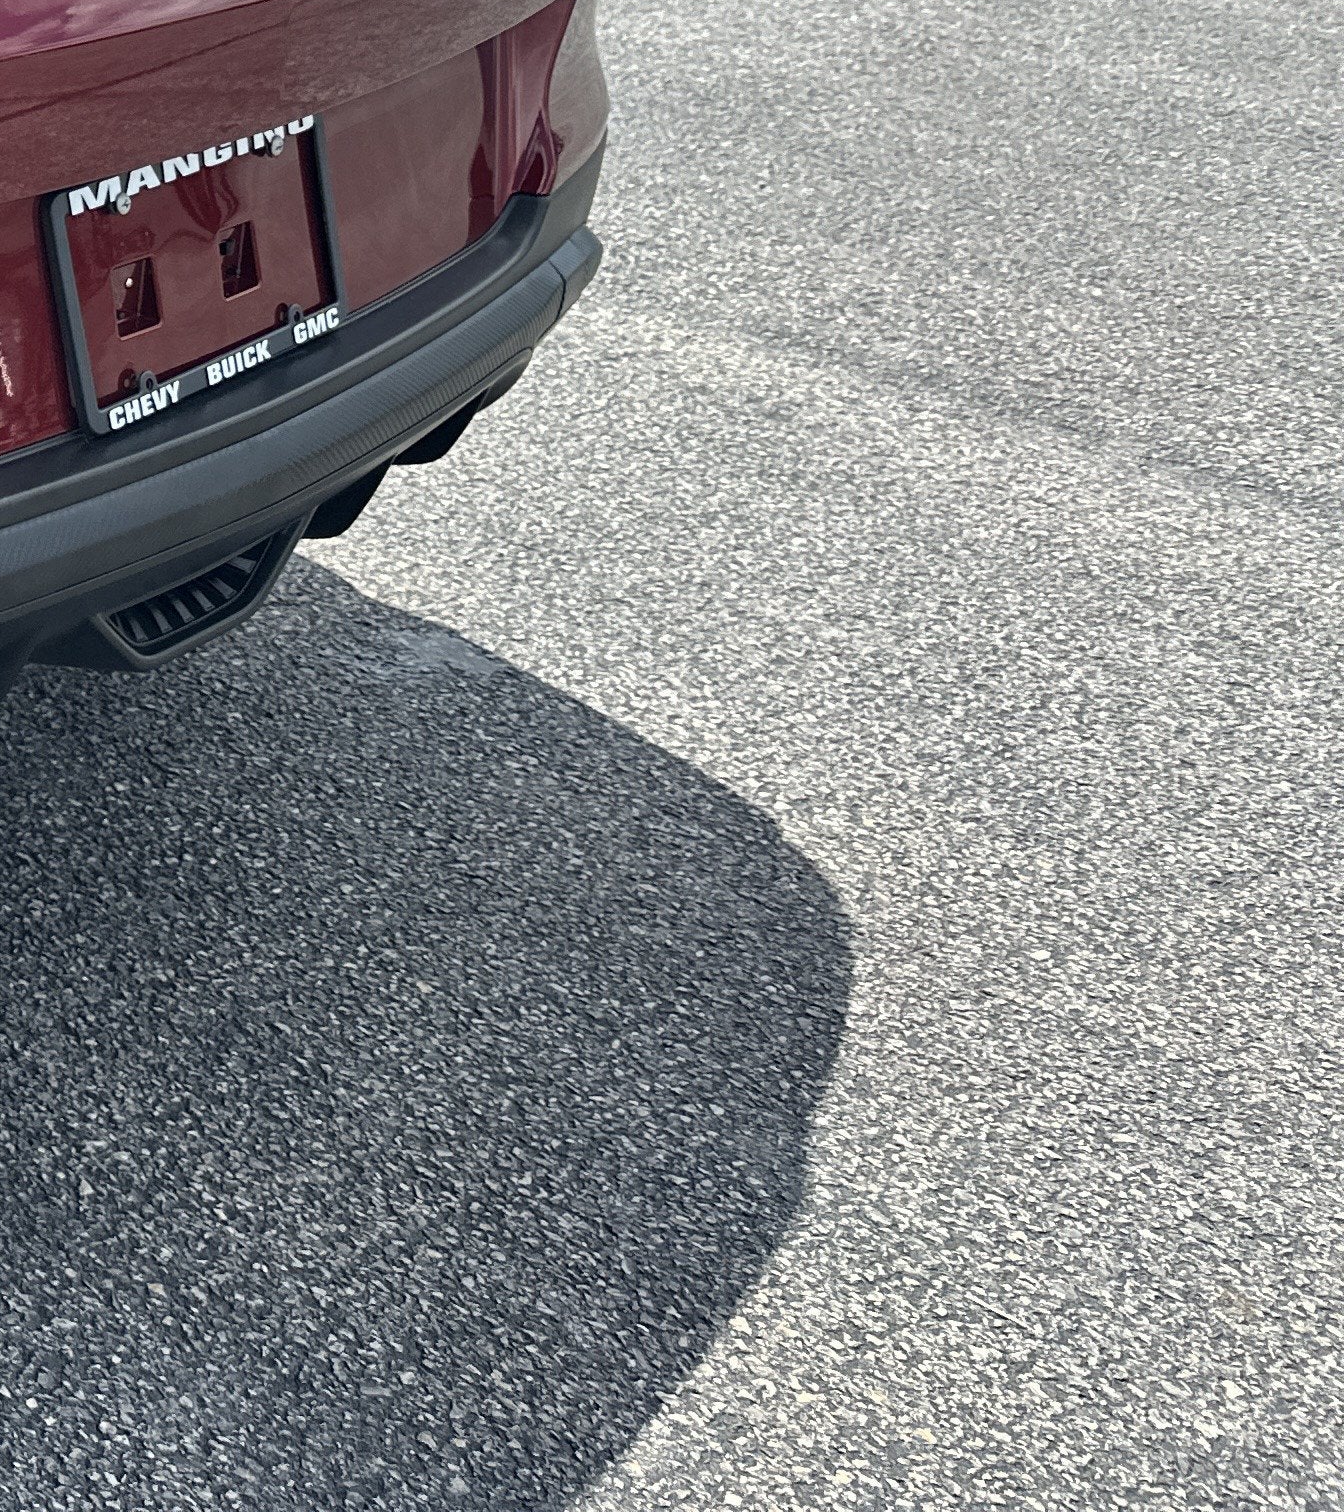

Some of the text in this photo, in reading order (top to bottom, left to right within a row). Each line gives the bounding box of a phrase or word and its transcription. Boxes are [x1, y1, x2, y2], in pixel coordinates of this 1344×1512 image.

[68, 114, 314, 216] MANGINO
[109, 306, 340, 430] CHEVY BUICK GMC
